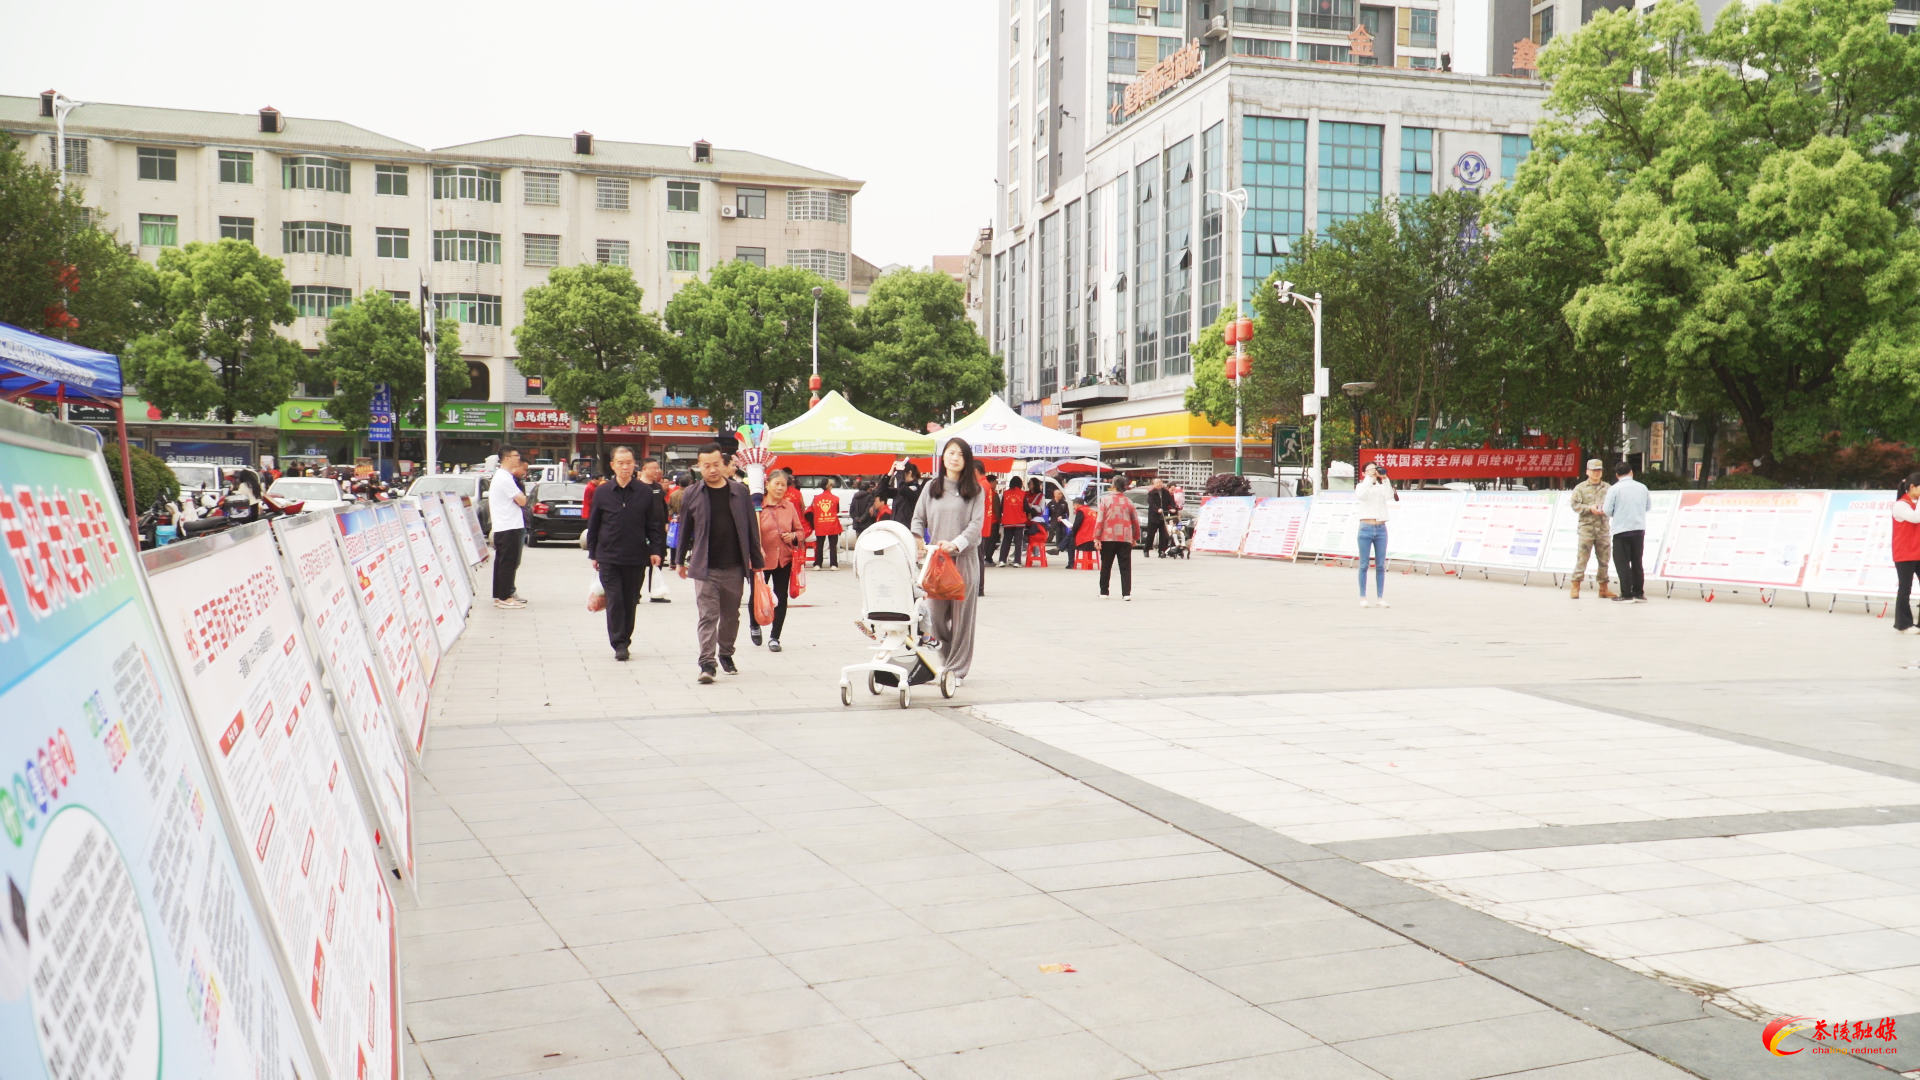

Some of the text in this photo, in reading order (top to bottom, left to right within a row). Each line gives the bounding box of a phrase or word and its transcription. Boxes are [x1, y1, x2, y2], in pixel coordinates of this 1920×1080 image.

[745, 391, 759, 413] P
[1020, 445, 1070, 454] 定制美好生活
[1373, 452, 1575, 467] 共筑国家安全屏障 同绘和平发展蓝图
